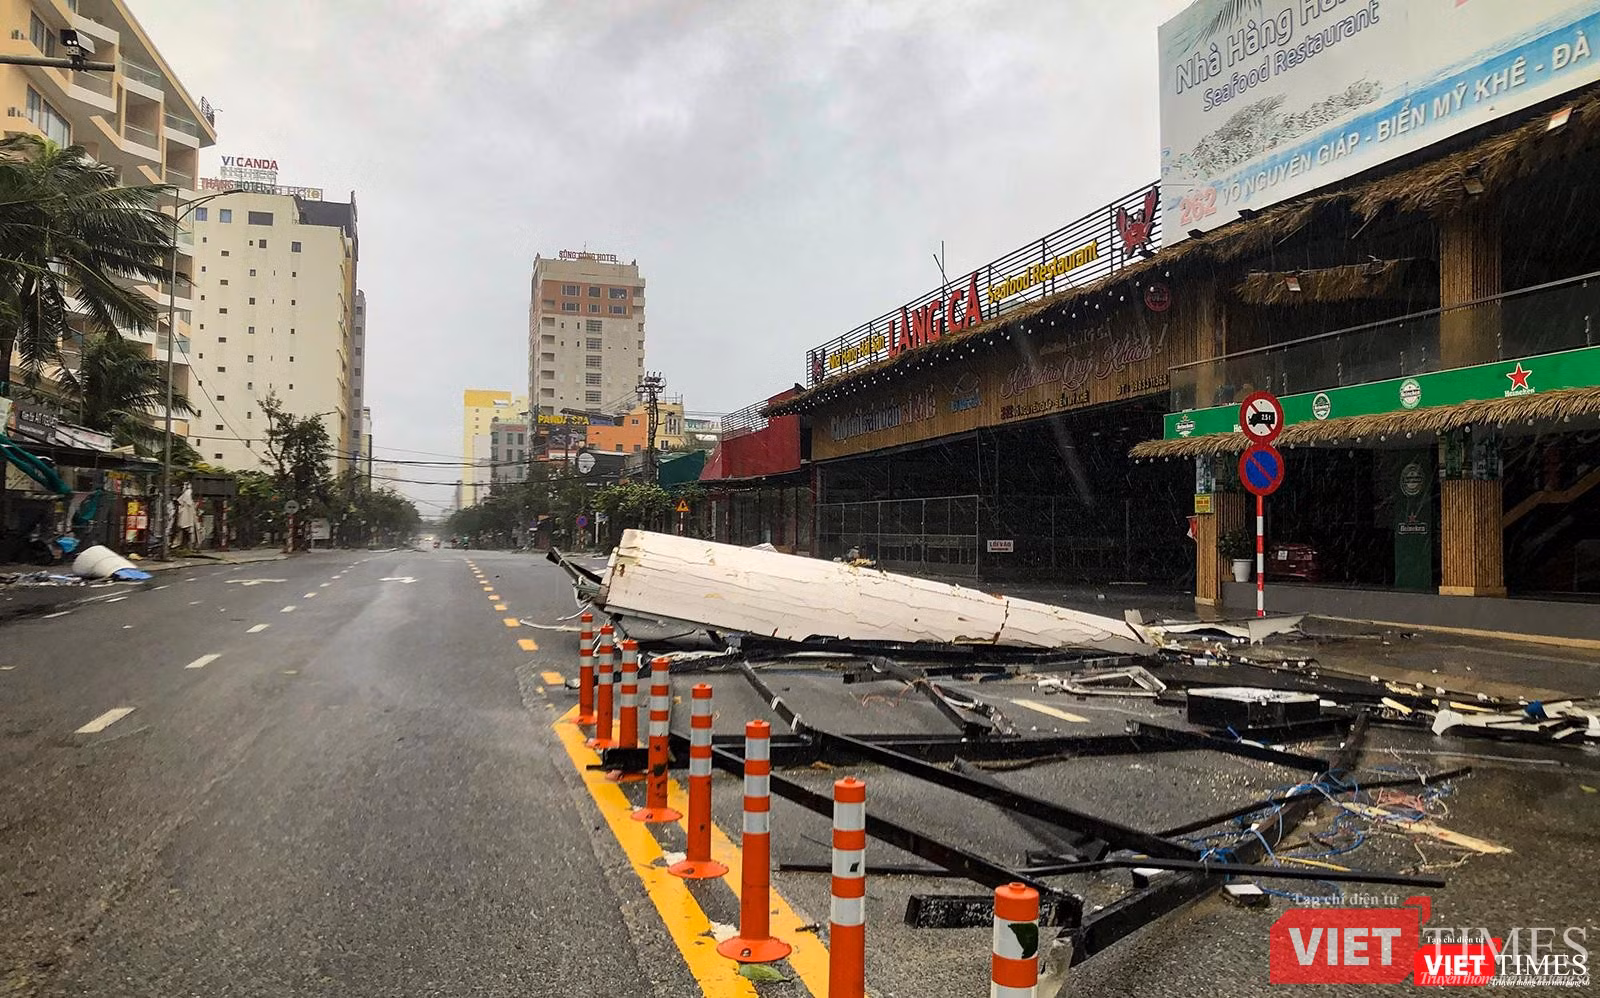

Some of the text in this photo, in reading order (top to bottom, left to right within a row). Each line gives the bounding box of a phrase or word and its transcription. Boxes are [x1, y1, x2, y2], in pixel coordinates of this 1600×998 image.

[1176, 43, 1222, 94] Nhà
[1227, 8, 1292, 68] Hàng
[1203, 0, 1380, 112] Seafood Restaurant
[1180, 186, 1217, 226] 262
[1317, 132, 1361, 167] GIÁP
[1376, 99, 1428, 142] BIỂN
[1433, 83, 1469, 120] MỸ
[1474, 56, 1527, 101] KHÊ
[1552, 29, 1592, 71] ĐÀ
[987, 239, 1099, 304] Seafood Restaurant
[888, 272, 984, 358] LÀNG CÁ
[1503, 386, 1536, 398] Heineken
